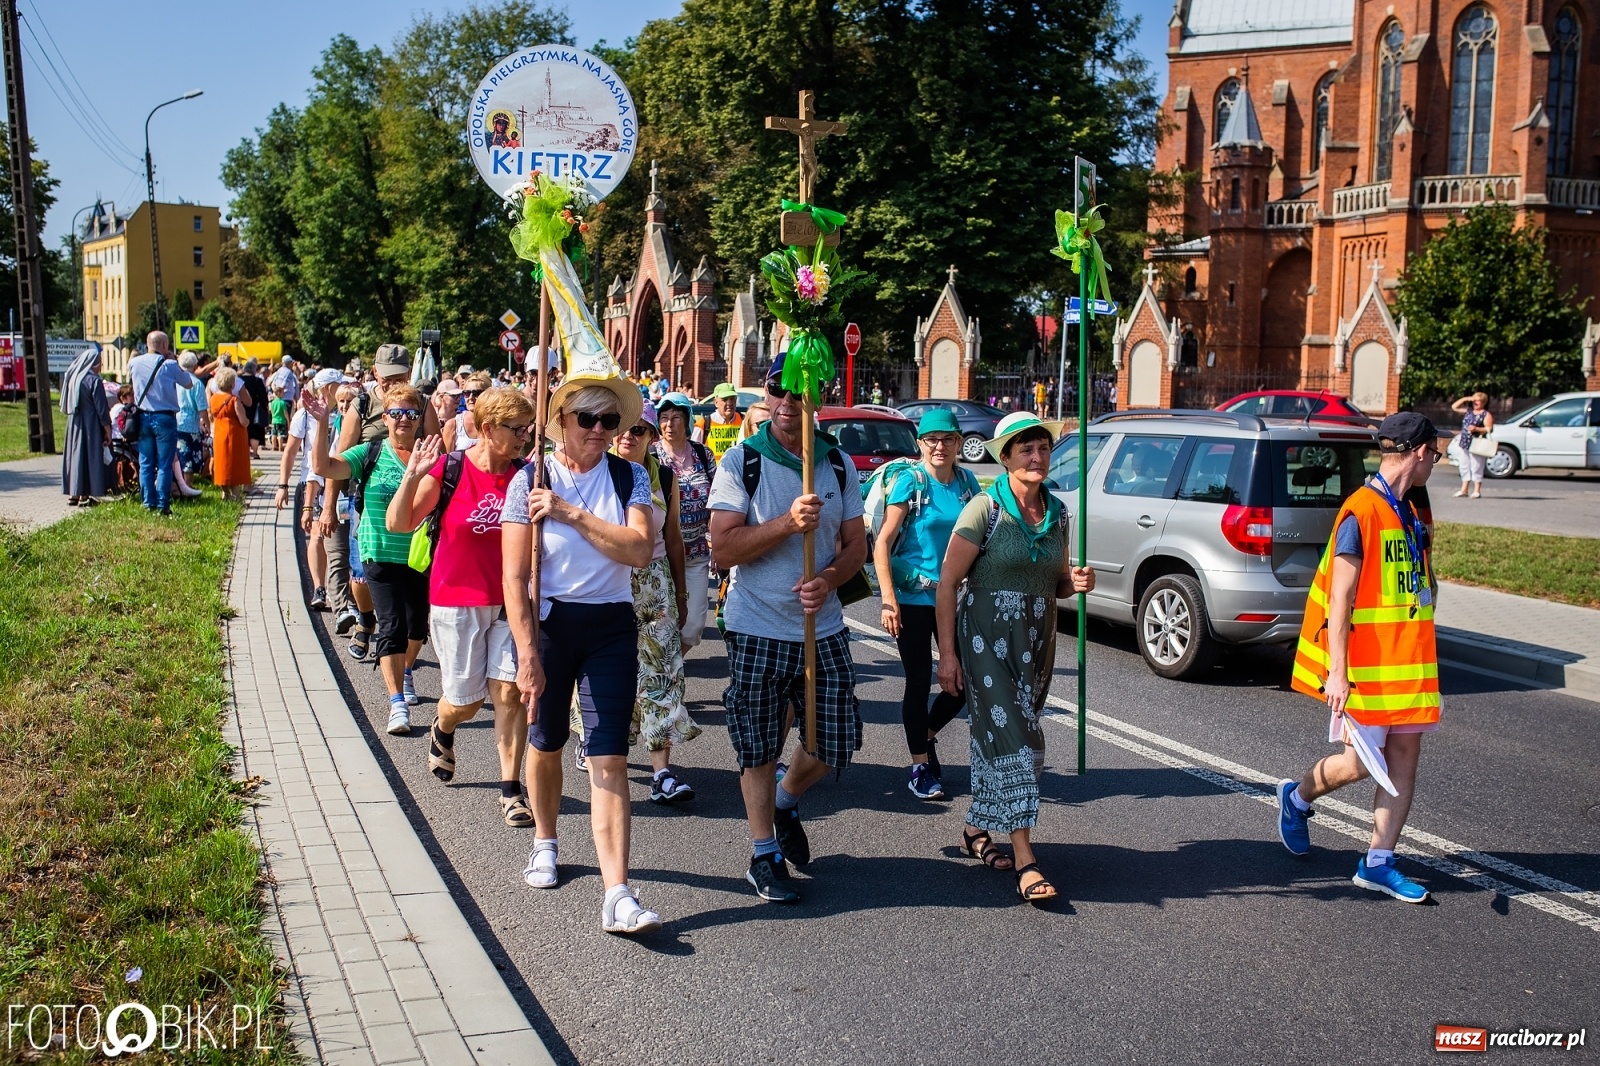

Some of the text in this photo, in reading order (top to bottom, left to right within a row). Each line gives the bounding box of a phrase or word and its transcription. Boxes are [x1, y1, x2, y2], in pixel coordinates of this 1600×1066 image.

[472, 87, 494, 148] OPOLSKA
[489, 49, 579, 87] PIELGRZYMKA
[581, 57, 602, 78] NA
[600, 74, 630, 117] JASNĄ
[492, 149, 613, 180] KIETRZ
[477, 493, 505, 511] Su
[824, 491, 835, 500] 4F
